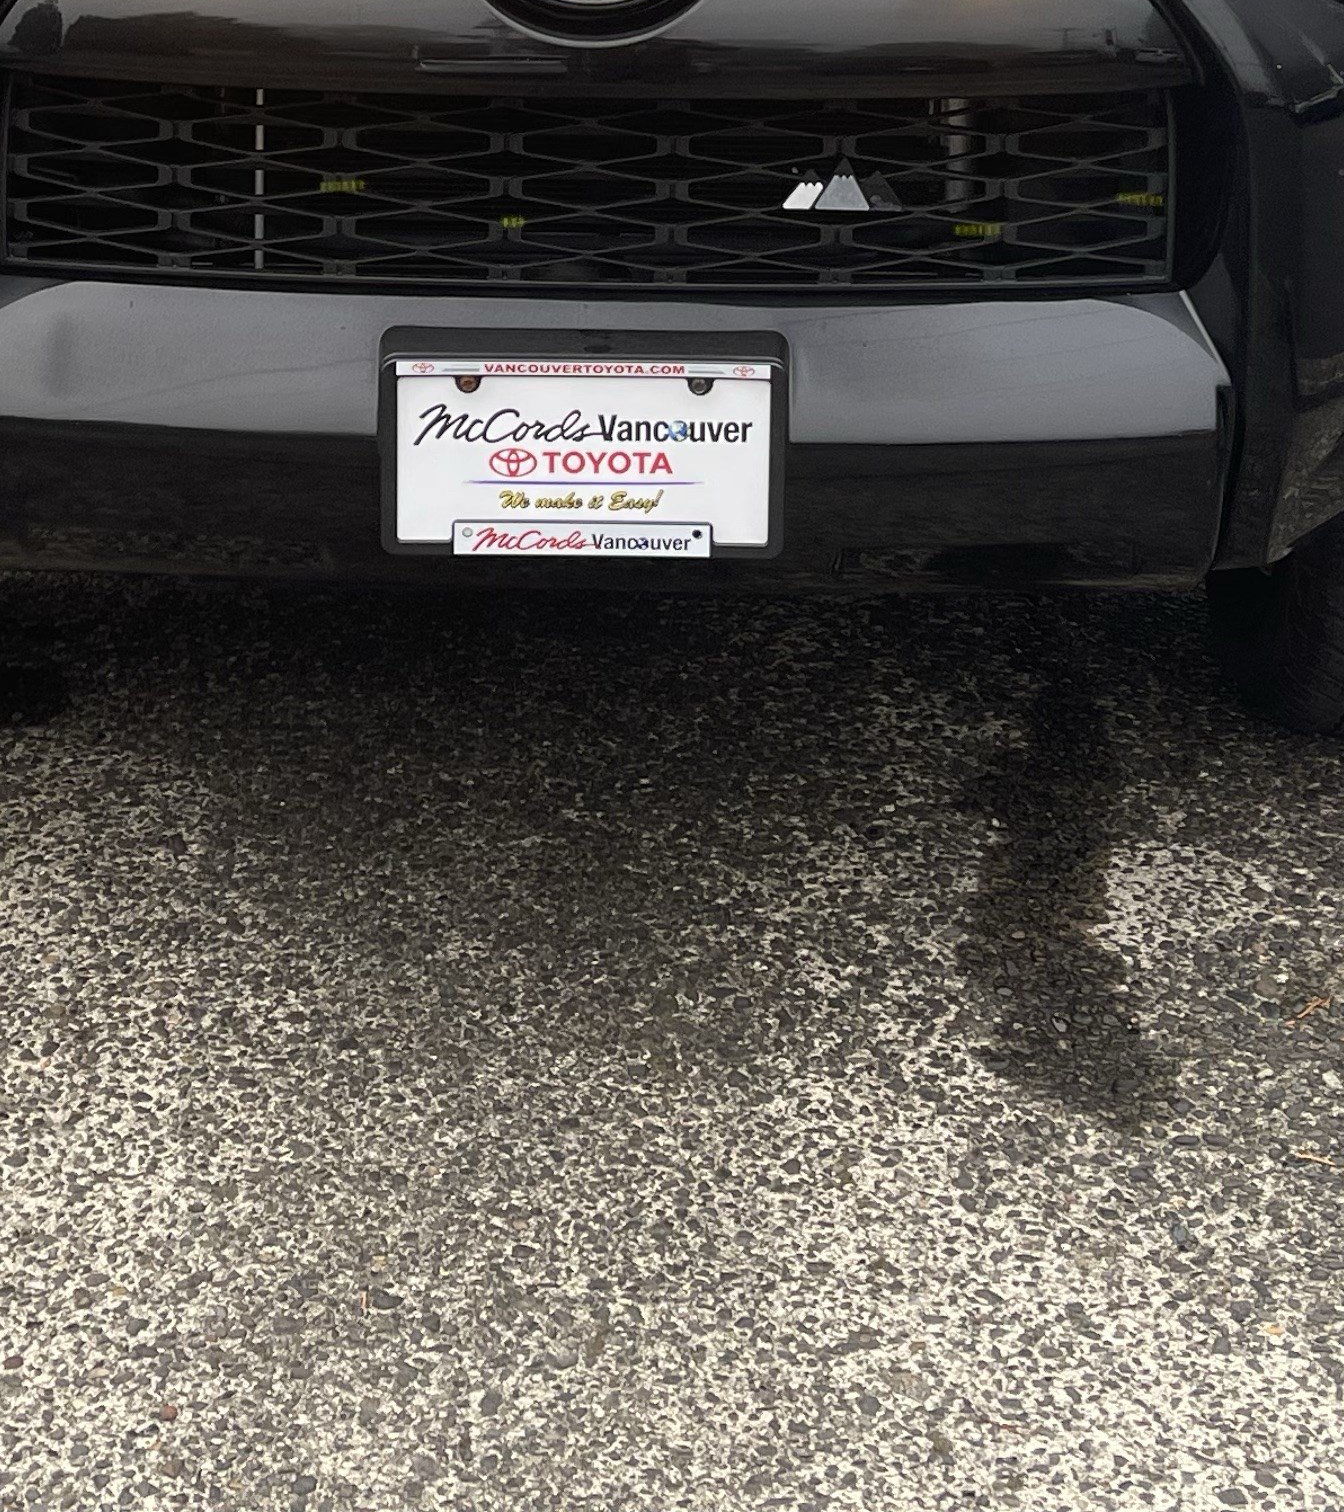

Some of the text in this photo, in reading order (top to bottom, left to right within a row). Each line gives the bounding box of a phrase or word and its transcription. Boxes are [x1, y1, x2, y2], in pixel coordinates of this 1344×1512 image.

[484, 363, 685, 375] VANCOUVERTOYOTA.COM
[413, 403, 598, 447] McCords
[542, 451, 673, 474] TOYOTA
[498, 488, 664, 514] We make it Easy!
[471, 527, 590, 552] McCords
